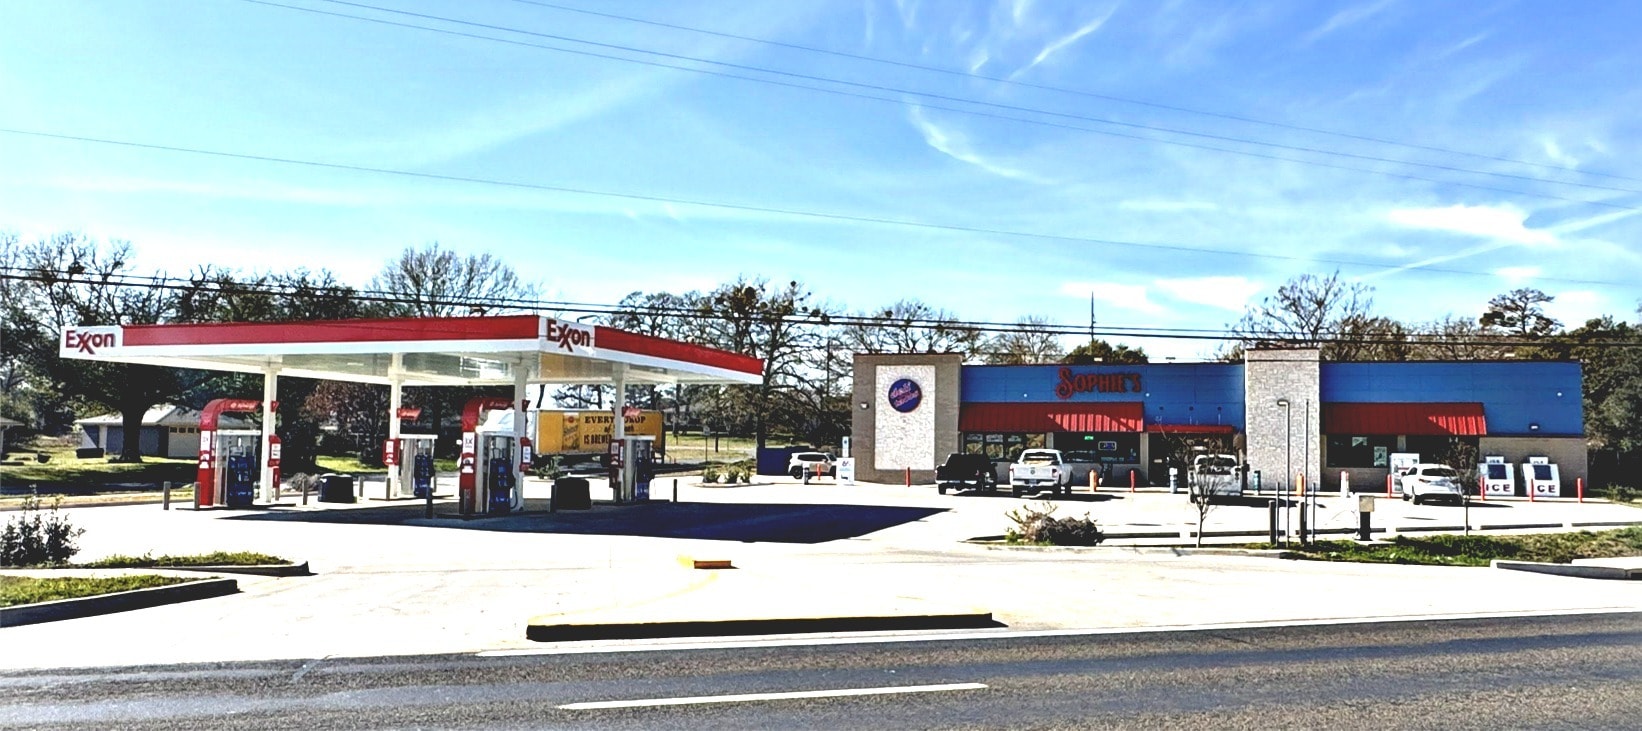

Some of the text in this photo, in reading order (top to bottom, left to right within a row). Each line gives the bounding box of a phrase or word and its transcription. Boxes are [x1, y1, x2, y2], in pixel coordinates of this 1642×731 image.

[65, 330, 115, 354] Exxon
[547, 319, 591, 352] Exxon
[1486, 484, 1511, 492] ICE
[1537, 485, 1556, 493] CE
